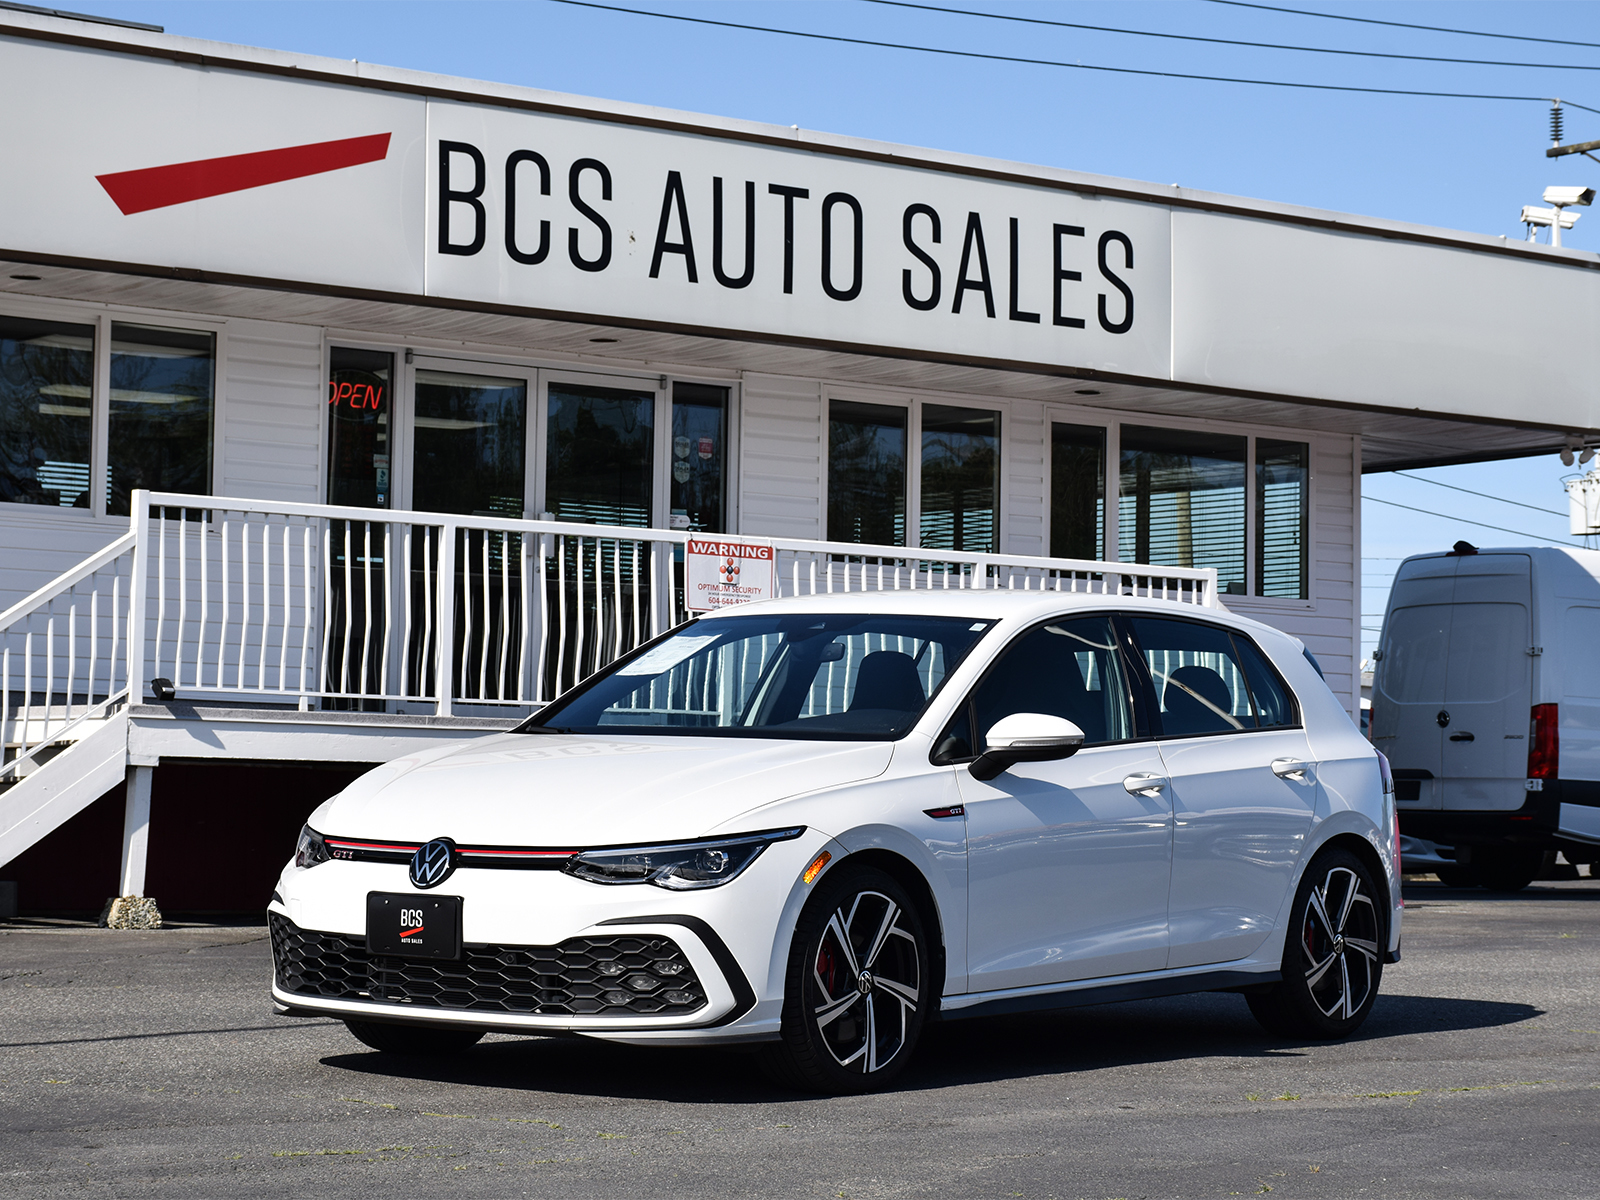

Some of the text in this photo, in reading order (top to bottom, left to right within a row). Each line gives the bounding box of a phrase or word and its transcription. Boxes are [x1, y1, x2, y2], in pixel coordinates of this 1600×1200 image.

[438, 139, 1135, 334] BCS AUTO SALES
[328, 381, 383, 410] OPEN
[691, 541, 769, 559] WARNING
[697, 583, 730, 593] OPTIMUM
[732, 586, 762, 595] SECURITY
[708, 596, 751, 606] 604-644-9
[333, 850, 354, 859] GTI
[400, 908, 424, 928] BCS
